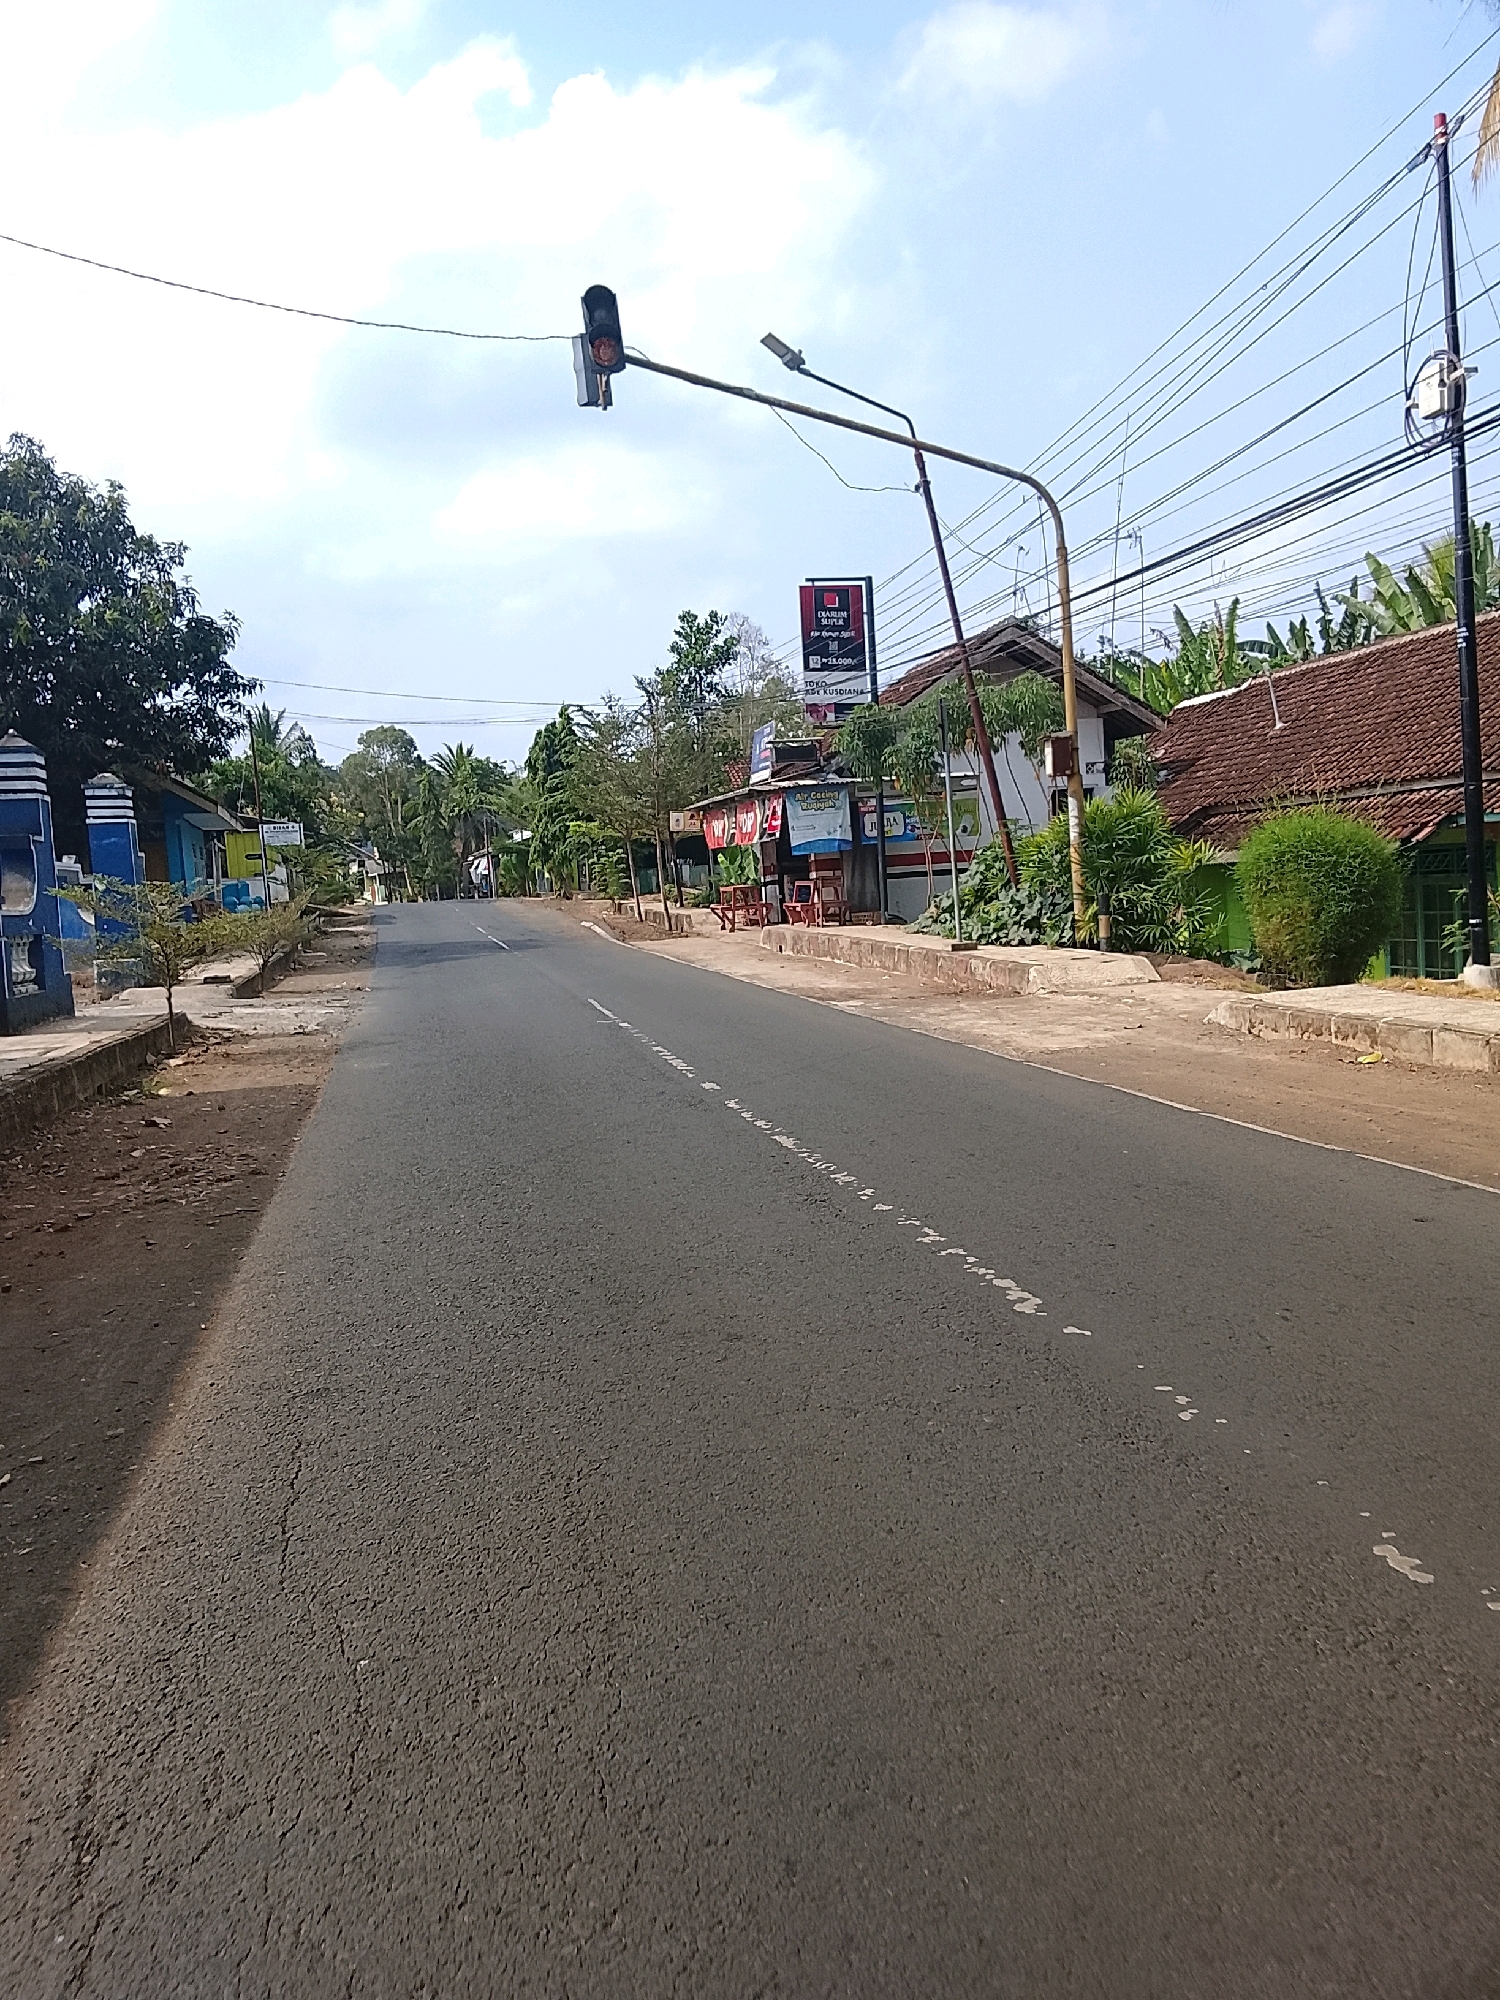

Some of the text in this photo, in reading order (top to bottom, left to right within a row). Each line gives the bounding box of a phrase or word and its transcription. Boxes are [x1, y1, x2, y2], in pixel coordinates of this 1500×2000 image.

[804, 680, 827, 688] TOKO
[795, 790, 839, 801] Air Cacing
